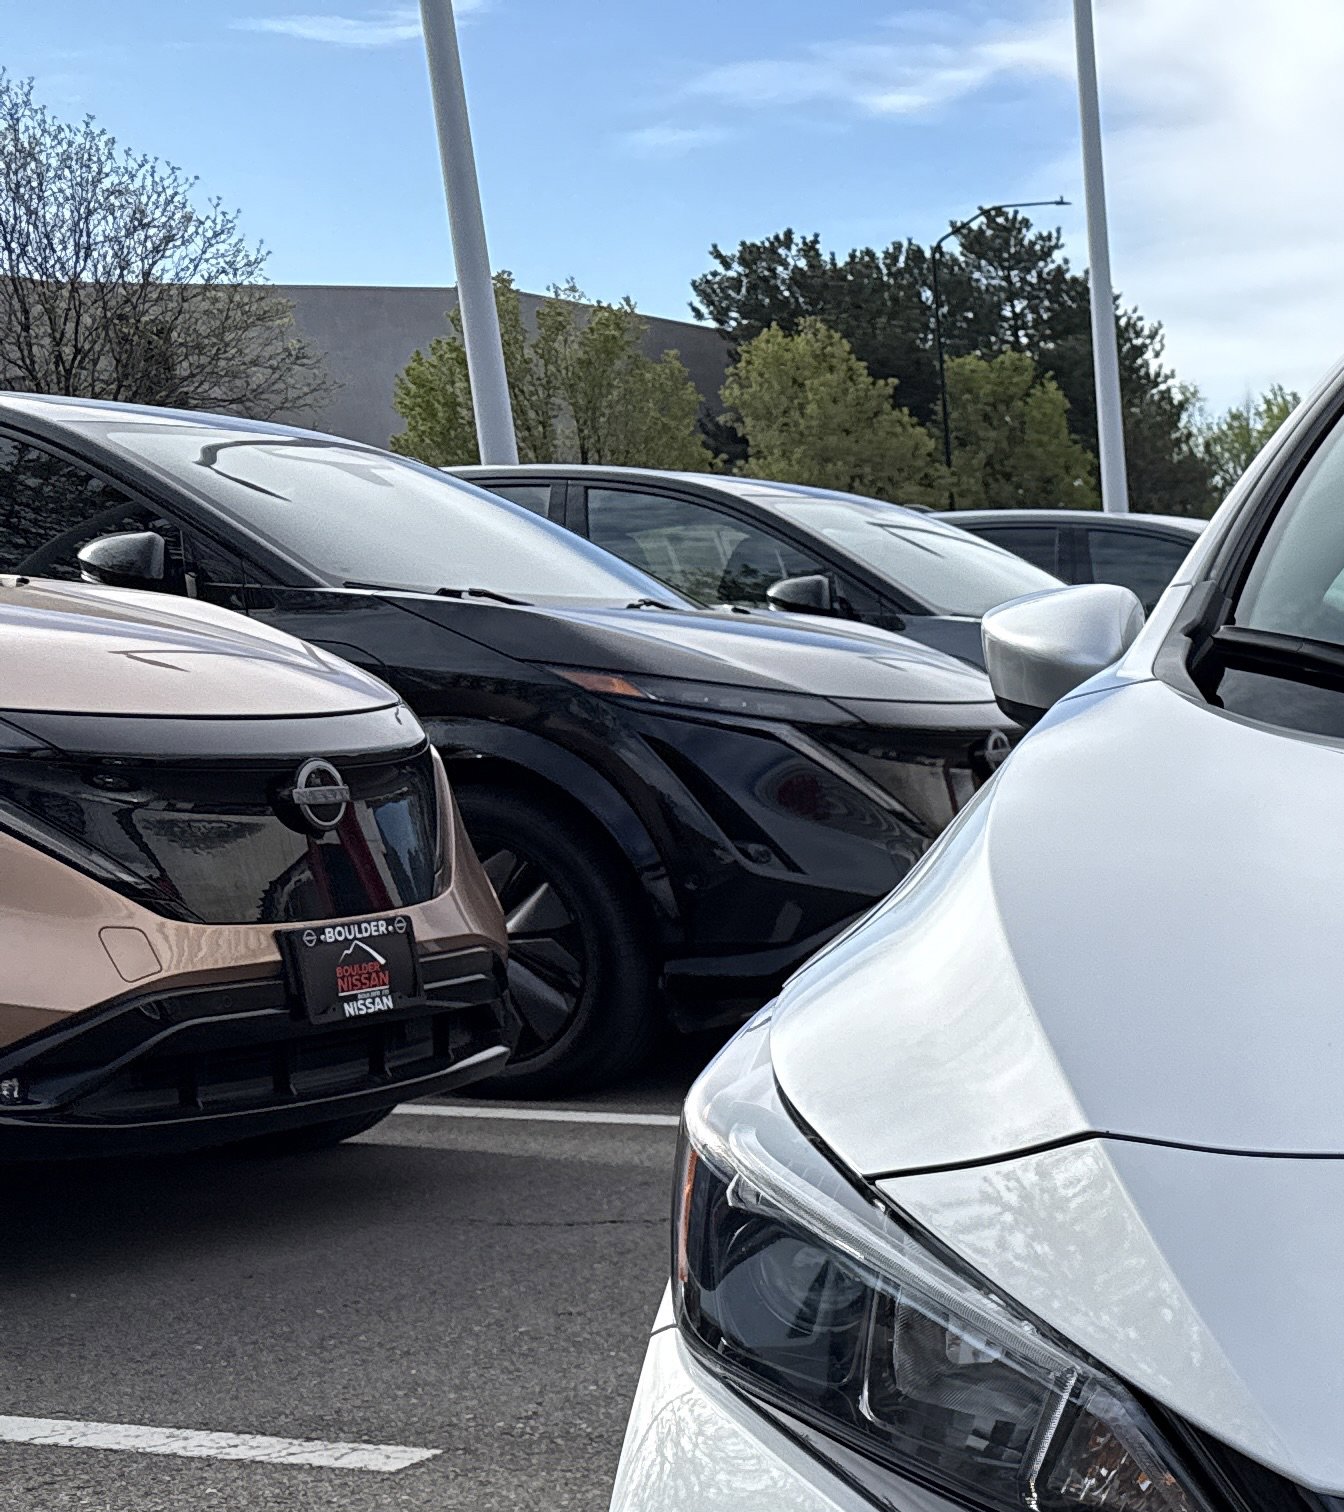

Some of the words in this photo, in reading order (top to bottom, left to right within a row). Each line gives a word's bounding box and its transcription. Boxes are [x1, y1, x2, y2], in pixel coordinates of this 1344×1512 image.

[324, 920, 388, 943] BOULDER
[336, 961, 380, 978] BOULDER
[337, 970, 389, 992] NISSAN
[343, 994, 394, 1018] NISSAN
